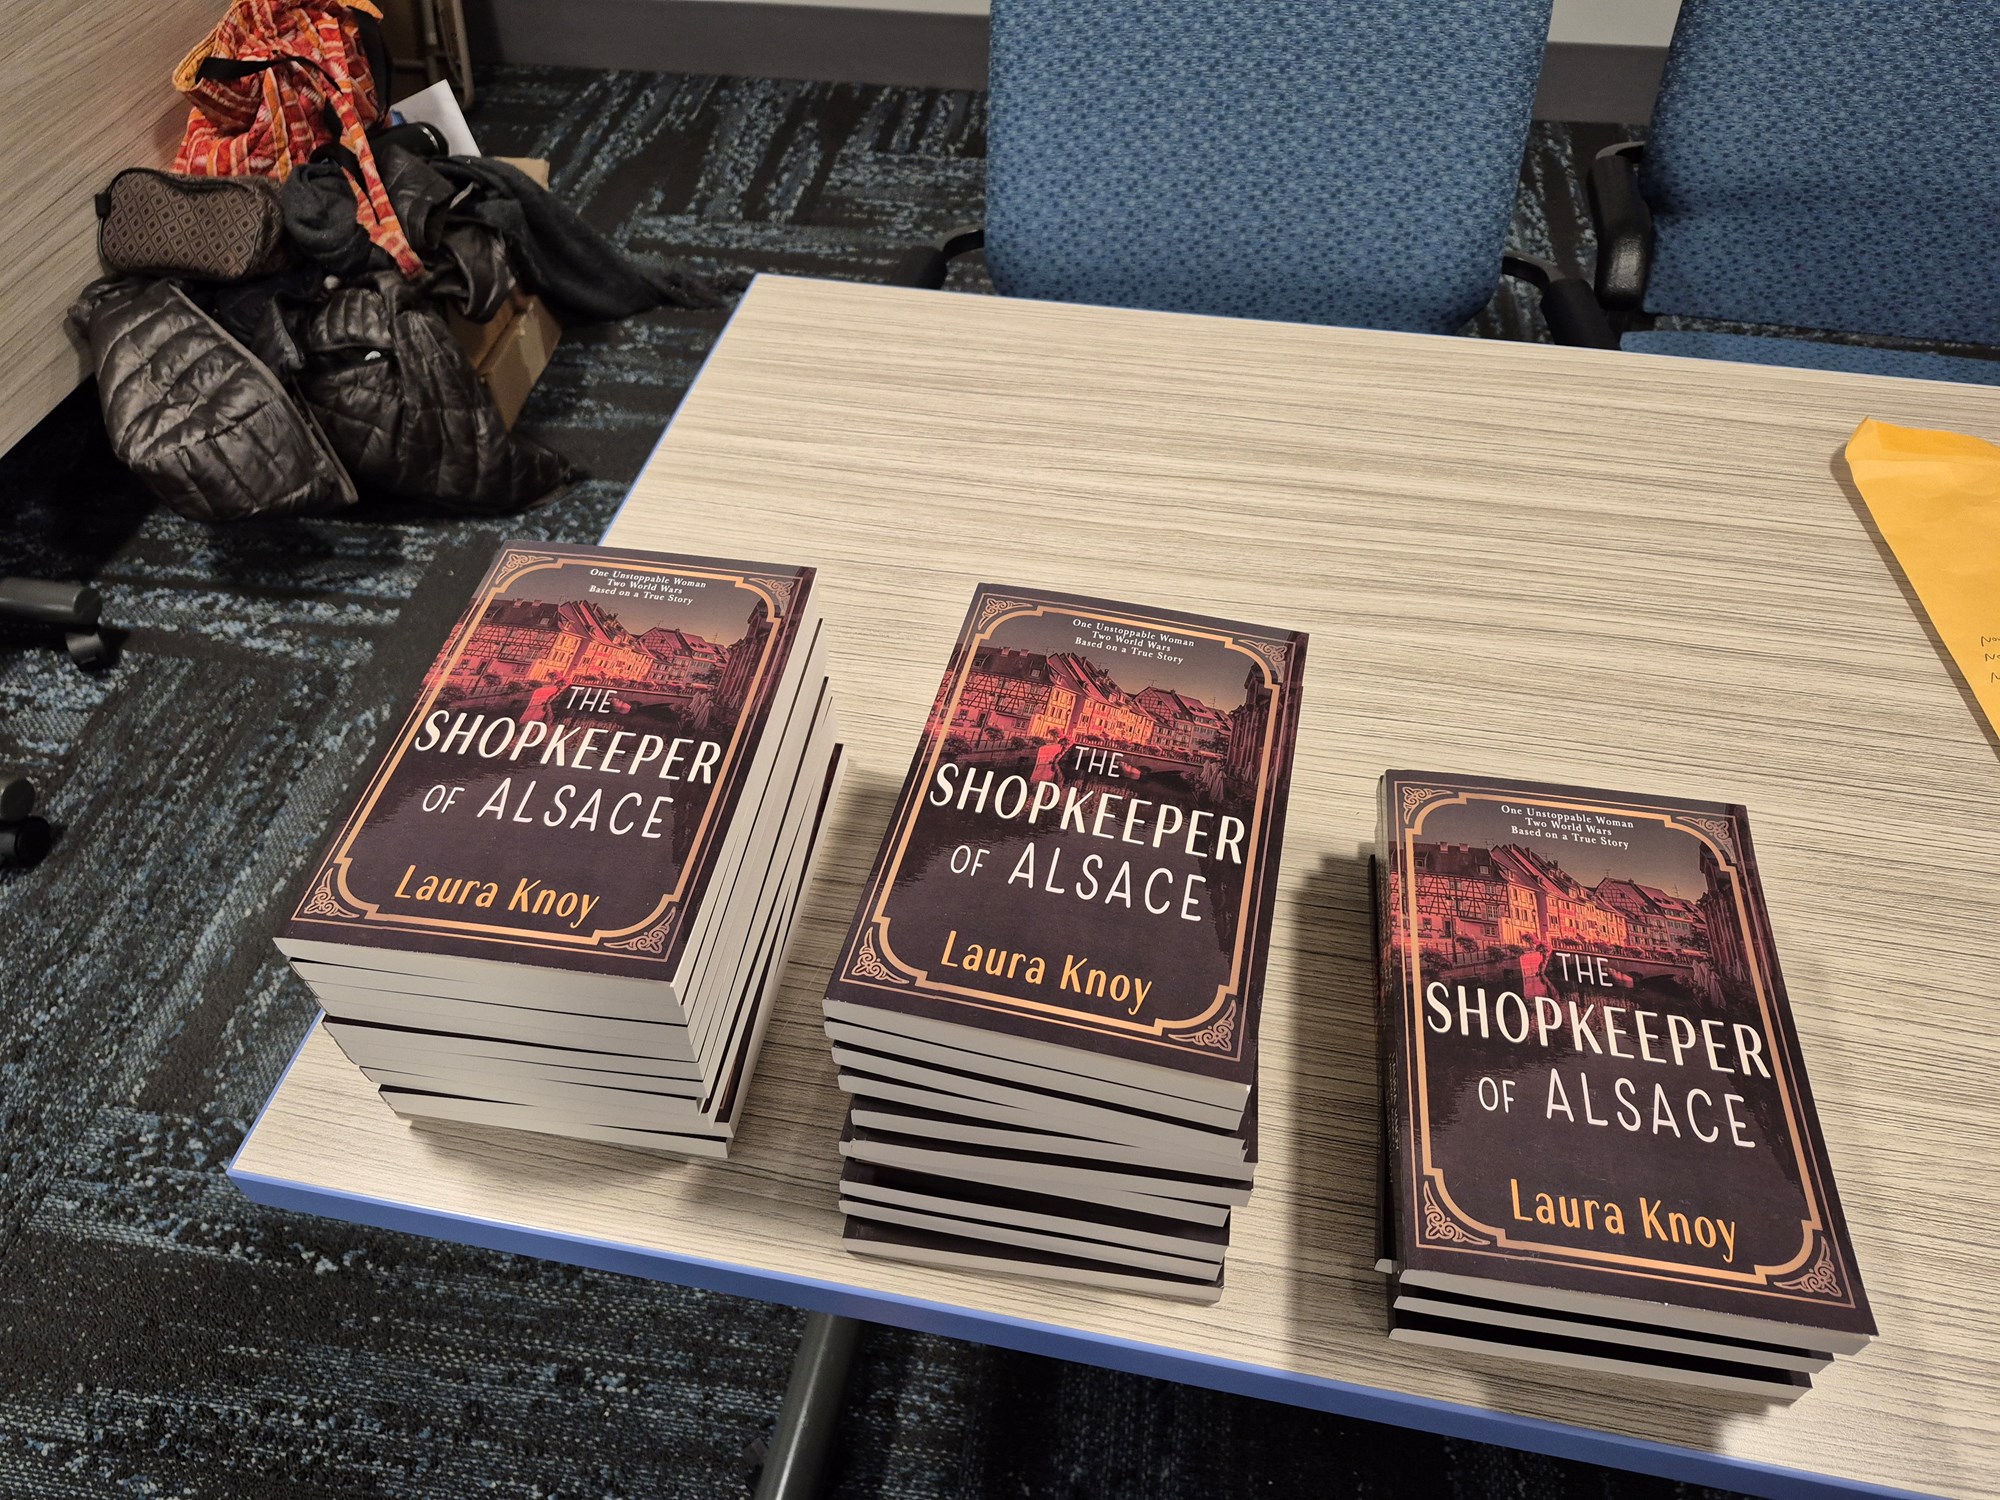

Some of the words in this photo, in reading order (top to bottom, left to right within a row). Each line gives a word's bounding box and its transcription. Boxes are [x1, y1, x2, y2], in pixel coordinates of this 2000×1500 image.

[588, 585, 617, 595] Based
[644, 592, 664, 601] True
[668, 594, 694, 606] Story
[590, 568, 609, 577] One
[612, 571, 670, 584] Unstoppable
[673, 578, 706, 588] Woman
[607, 578, 626, 588] Two
[630, 581, 657, 591] World
[660, 584, 683, 594] Wars
[1072, 618, 1092, 628] One
[1096, 623, 1156, 640] Unstoppable
[1160, 634, 1195, 647] Woman
[1075, 637, 1103, 649] Based
[1131, 647, 1154, 658] True
[1157, 652, 1184, 664] Story
[1092, 631, 1111, 641] Two
[1116, 635, 1144, 647] World
[1148, 640, 1171, 651] Wars
[565, 684, 618, 715] THE
[413, 708, 722, 785] SHOPKEEPER
[1073, 743, 1124, 779] THE
[421, 783, 466, 815] OF
[476, 776, 675, 840] ALSACE
[929, 761, 1246, 865] SHOPKEEPER
[1501, 804, 1522, 815] One
[1526, 808, 1592, 823] Unstoppable
[1595, 815, 1634, 828] Woman
[1511, 825, 1541, 837] Based
[1572, 832, 1597, 844] True
[1600, 837, 1629, 850] Story
[1525, 817, 1547, 828] Two
[1551, 821, 1582, 832] World
[1586, 824, 1612, 836] Wars
[394, 863, 499, 909] Laura
[508, 876, 600, 930] Knoy
[948, 843, 991, 878] OF
[1007, 842, 1208, 923] ALSACE
[940, 929, 1047, 986] Laura
[1060, 953, 1154, 1017] Knoy
[1554, 951, 1614, 988] THE
[1425, 980, 1772, 1080] SHOPKEEPER
[1477, 1075, 1517, 1115] OF
[1545, 1066, 1757, 1149] ALSACE
[1509, 1177, 1626, 1236] Laura
[1640, 1196, 1737, 1264] Knoy
